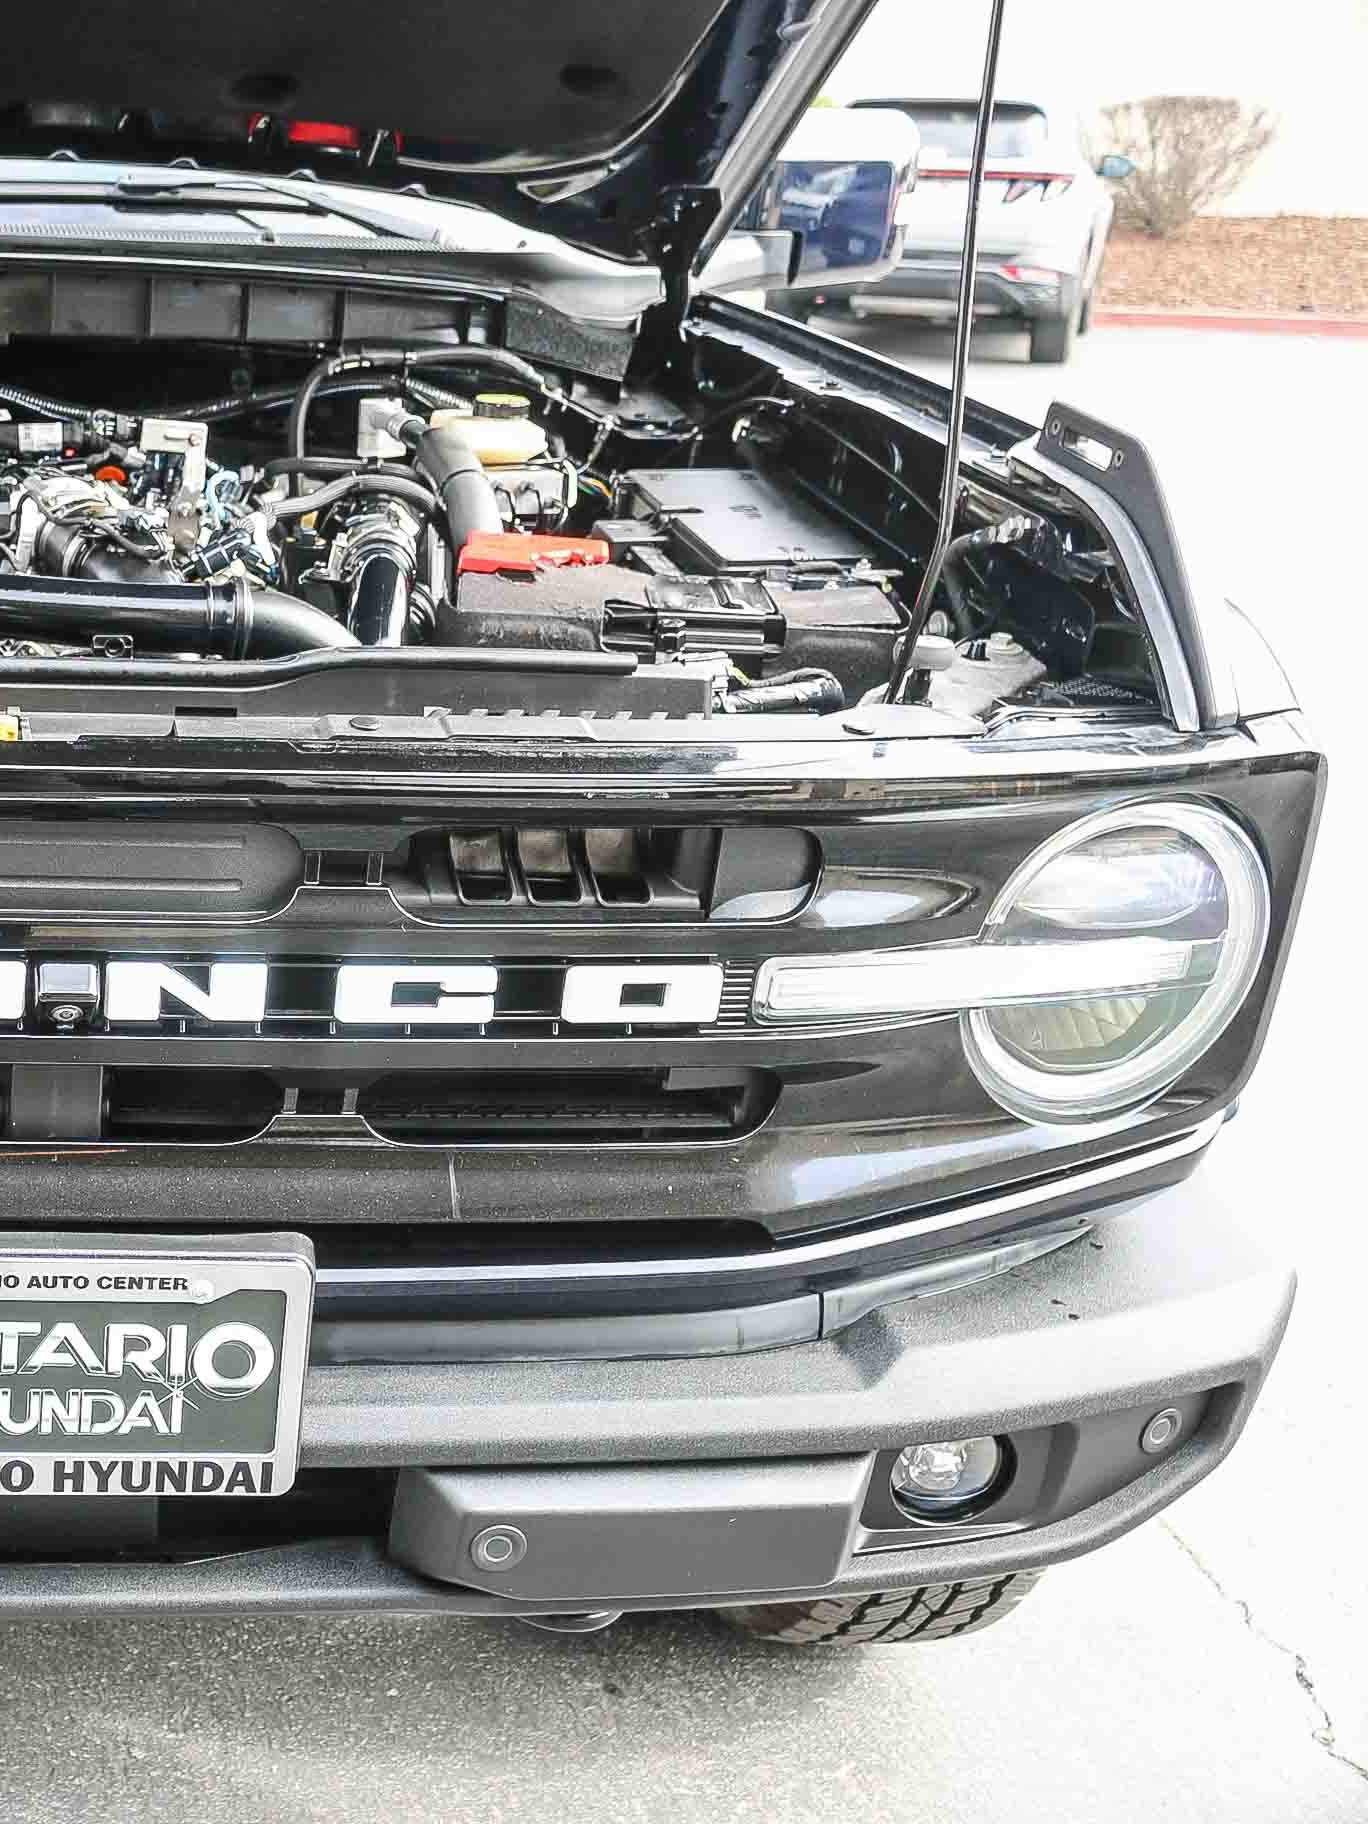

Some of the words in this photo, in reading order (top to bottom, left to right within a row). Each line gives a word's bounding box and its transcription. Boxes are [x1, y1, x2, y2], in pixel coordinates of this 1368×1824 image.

[26, 1275, 90, 1290] AUTO
[96, 1275, 190, 1291] CENTER
[52, 1461, 274, 1494] HYUNDAI
